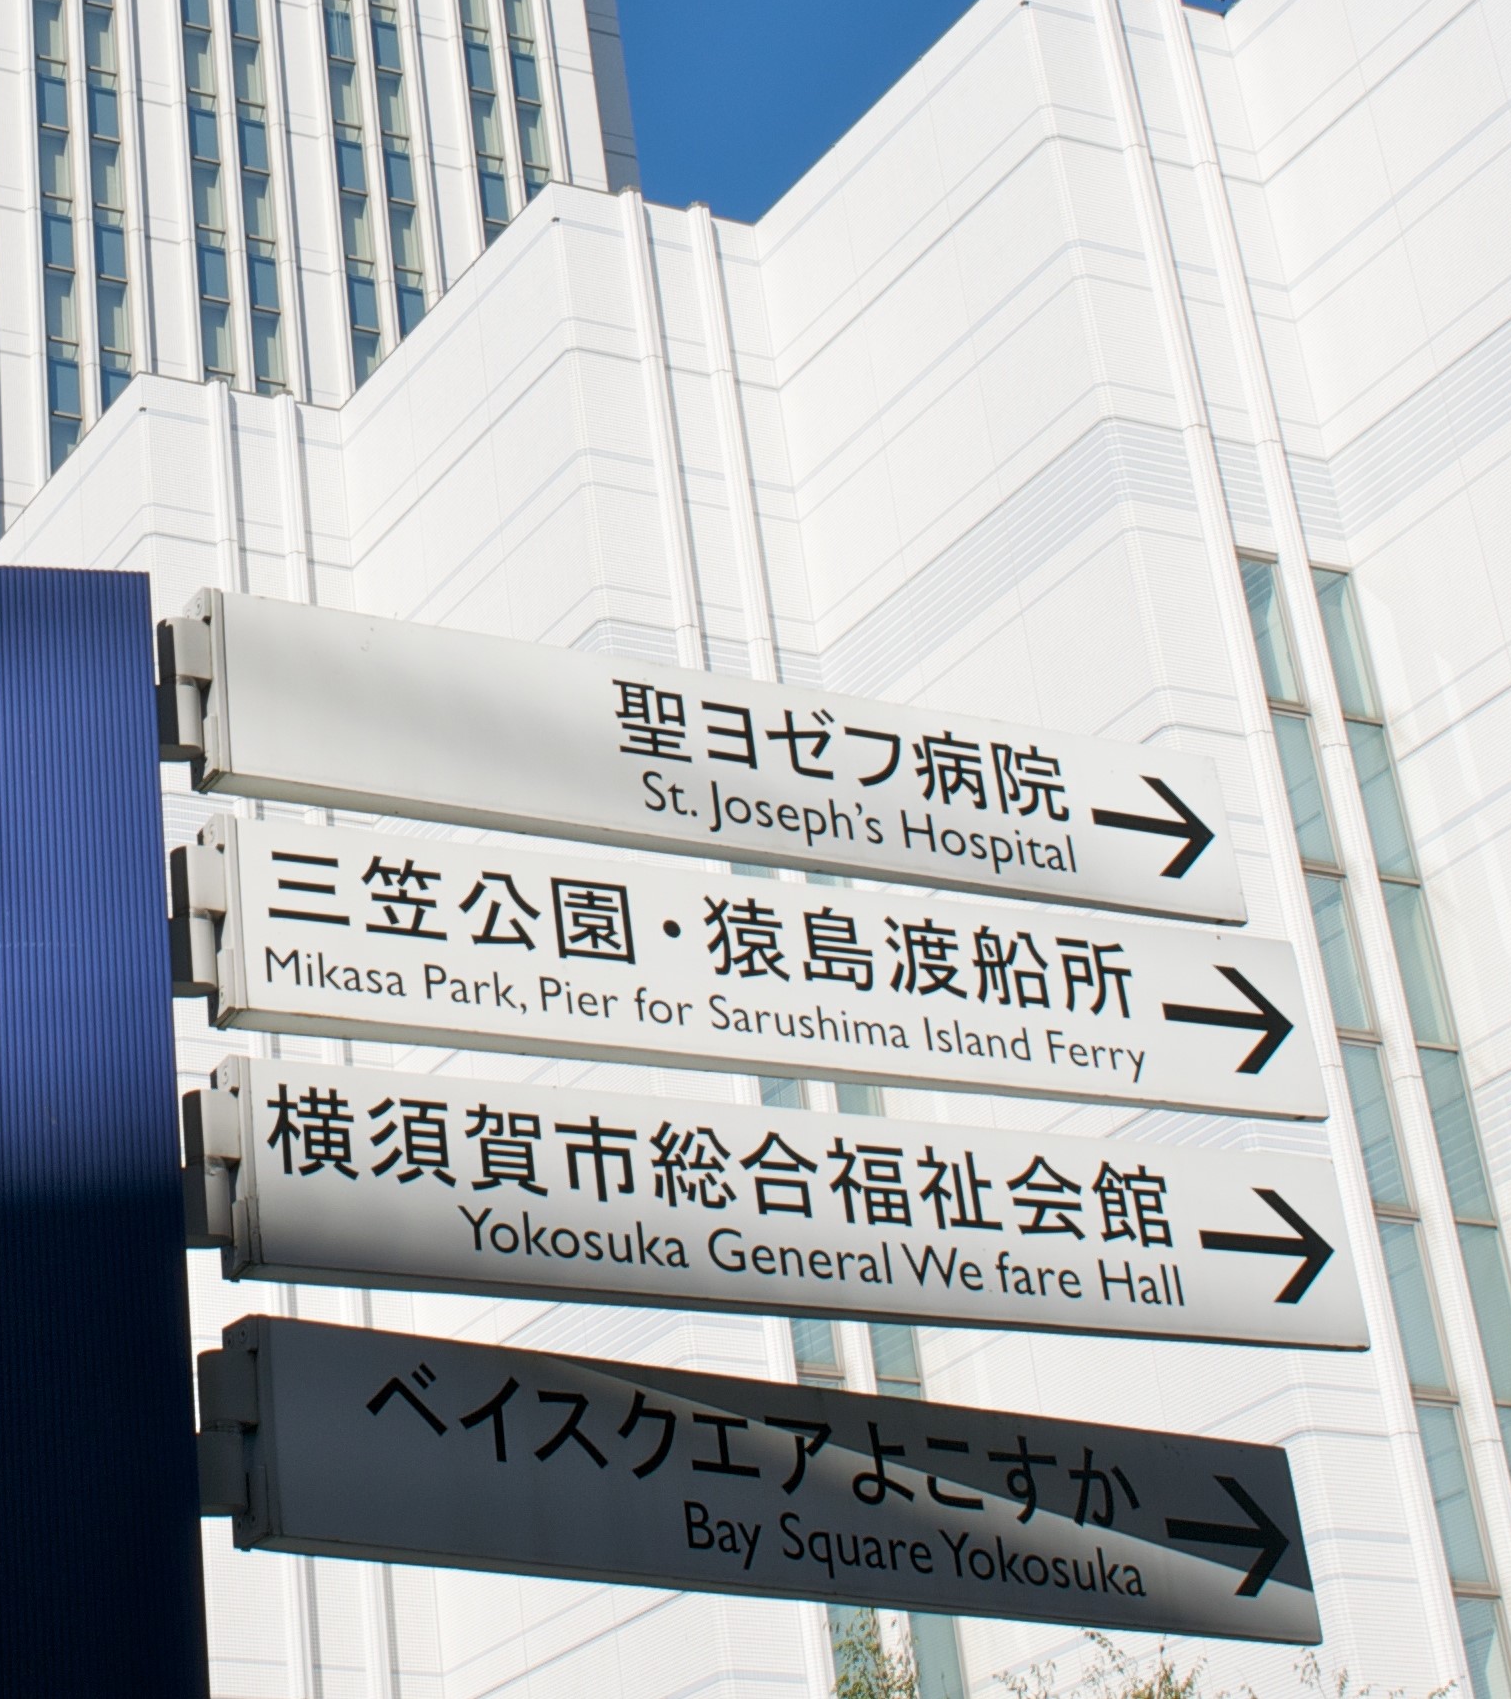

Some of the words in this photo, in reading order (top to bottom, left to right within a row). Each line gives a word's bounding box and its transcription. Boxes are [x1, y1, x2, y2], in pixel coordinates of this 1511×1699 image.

[612, 678, 1070, 822] 聖ヨゼフ病院
[642, 770, 698, 816] St.
[709, 780, 884, 847] Joseph's
[900, 809, 1077, 875] Hospital
[265, 946, 407, 997] Mikasa
[423, 963, 529, 1015] Park,
[539, 976, 619, 1019] Pier
[634, 986, 693, 1026] for
[708, 994, 910, 1049] Sarushima
[922, 1016, 1032, 1062] Island
[1046, 1029, 1145, 1084] Ferry
[266, 1083, 1174, 1249] 横須賀市総合福祉会館
[457, 1205, 690, 1269] Yokosuka
[707, 1227, 893, 1285] General
[1097, 1258, 1185, 1307] Hall
[366, 1362, 1141, 1530] ベイスクエアよこすか
[683, 1500, 762, 1571] Bay
[779, 1511, 934, 1580] Square
[936, 1528, 1148, 1599] Yokosuka
